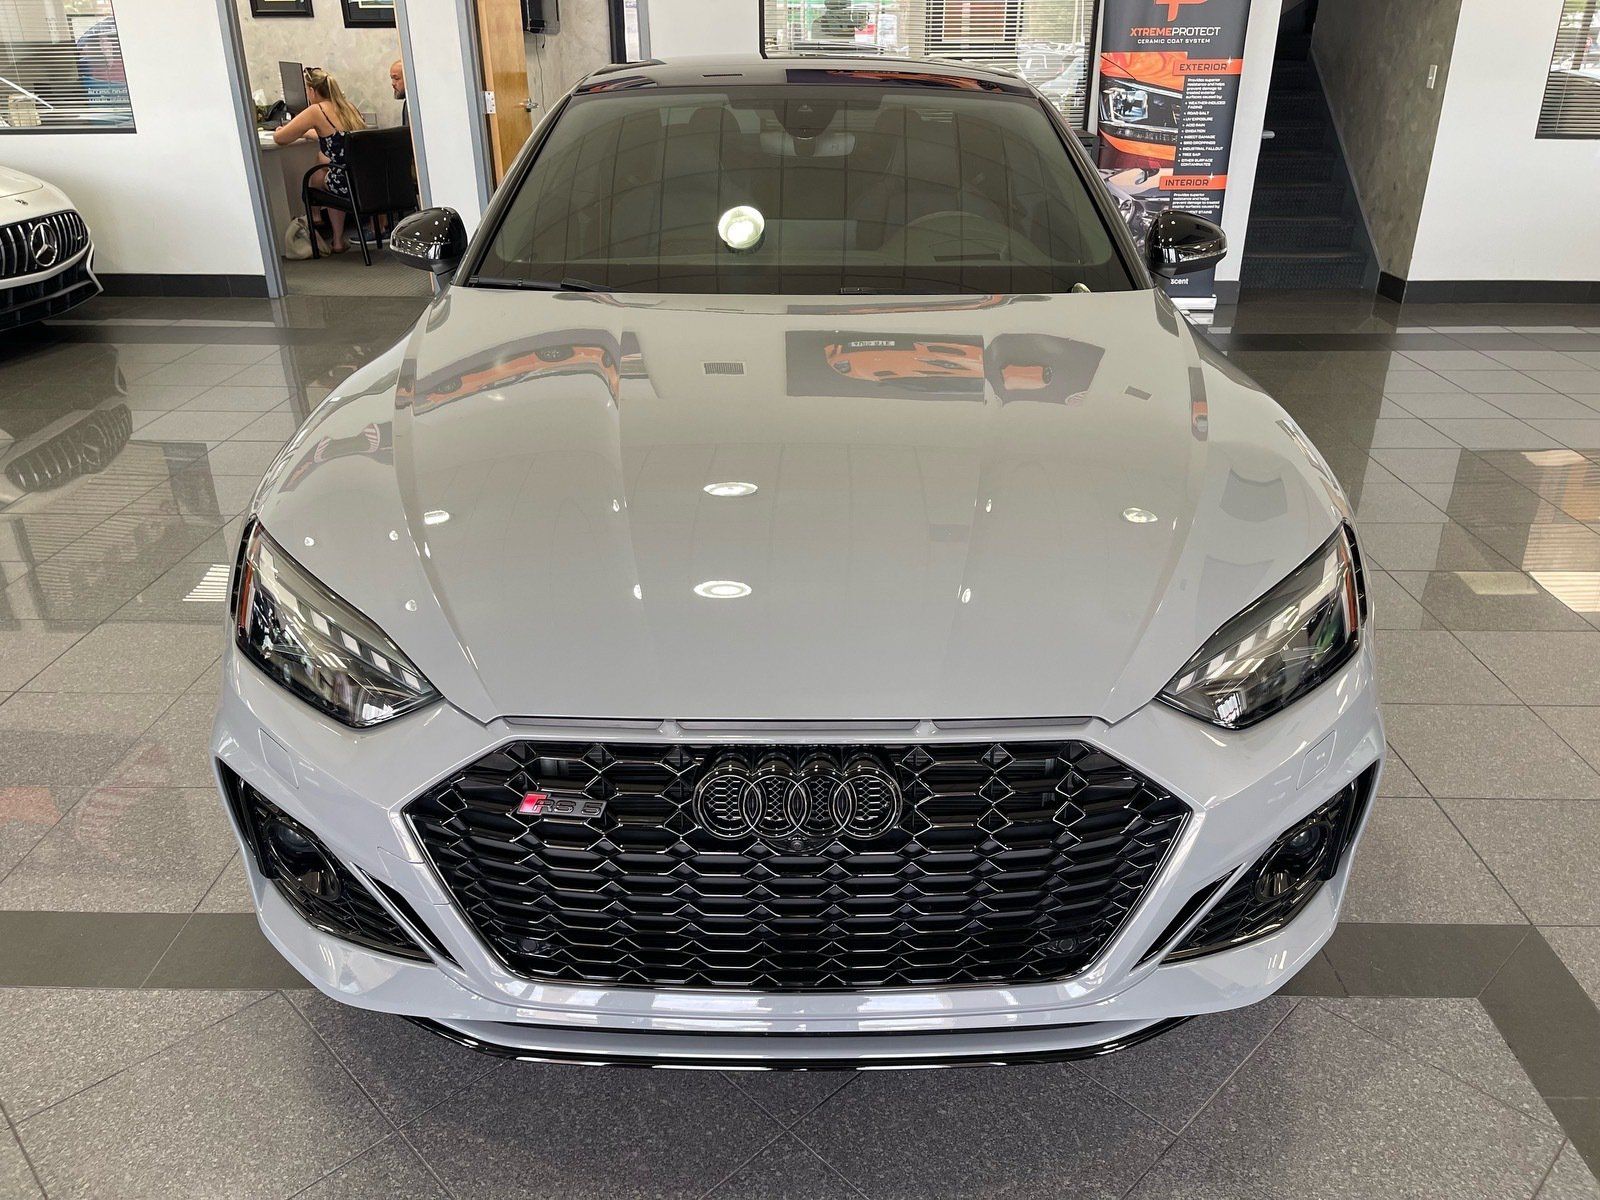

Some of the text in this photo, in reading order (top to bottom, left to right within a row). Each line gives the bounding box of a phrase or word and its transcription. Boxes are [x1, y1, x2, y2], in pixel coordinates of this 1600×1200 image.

[1130, 26, 1221, 36] XTREMEPROTECT
[532, 798, 604, 816] RS 5
